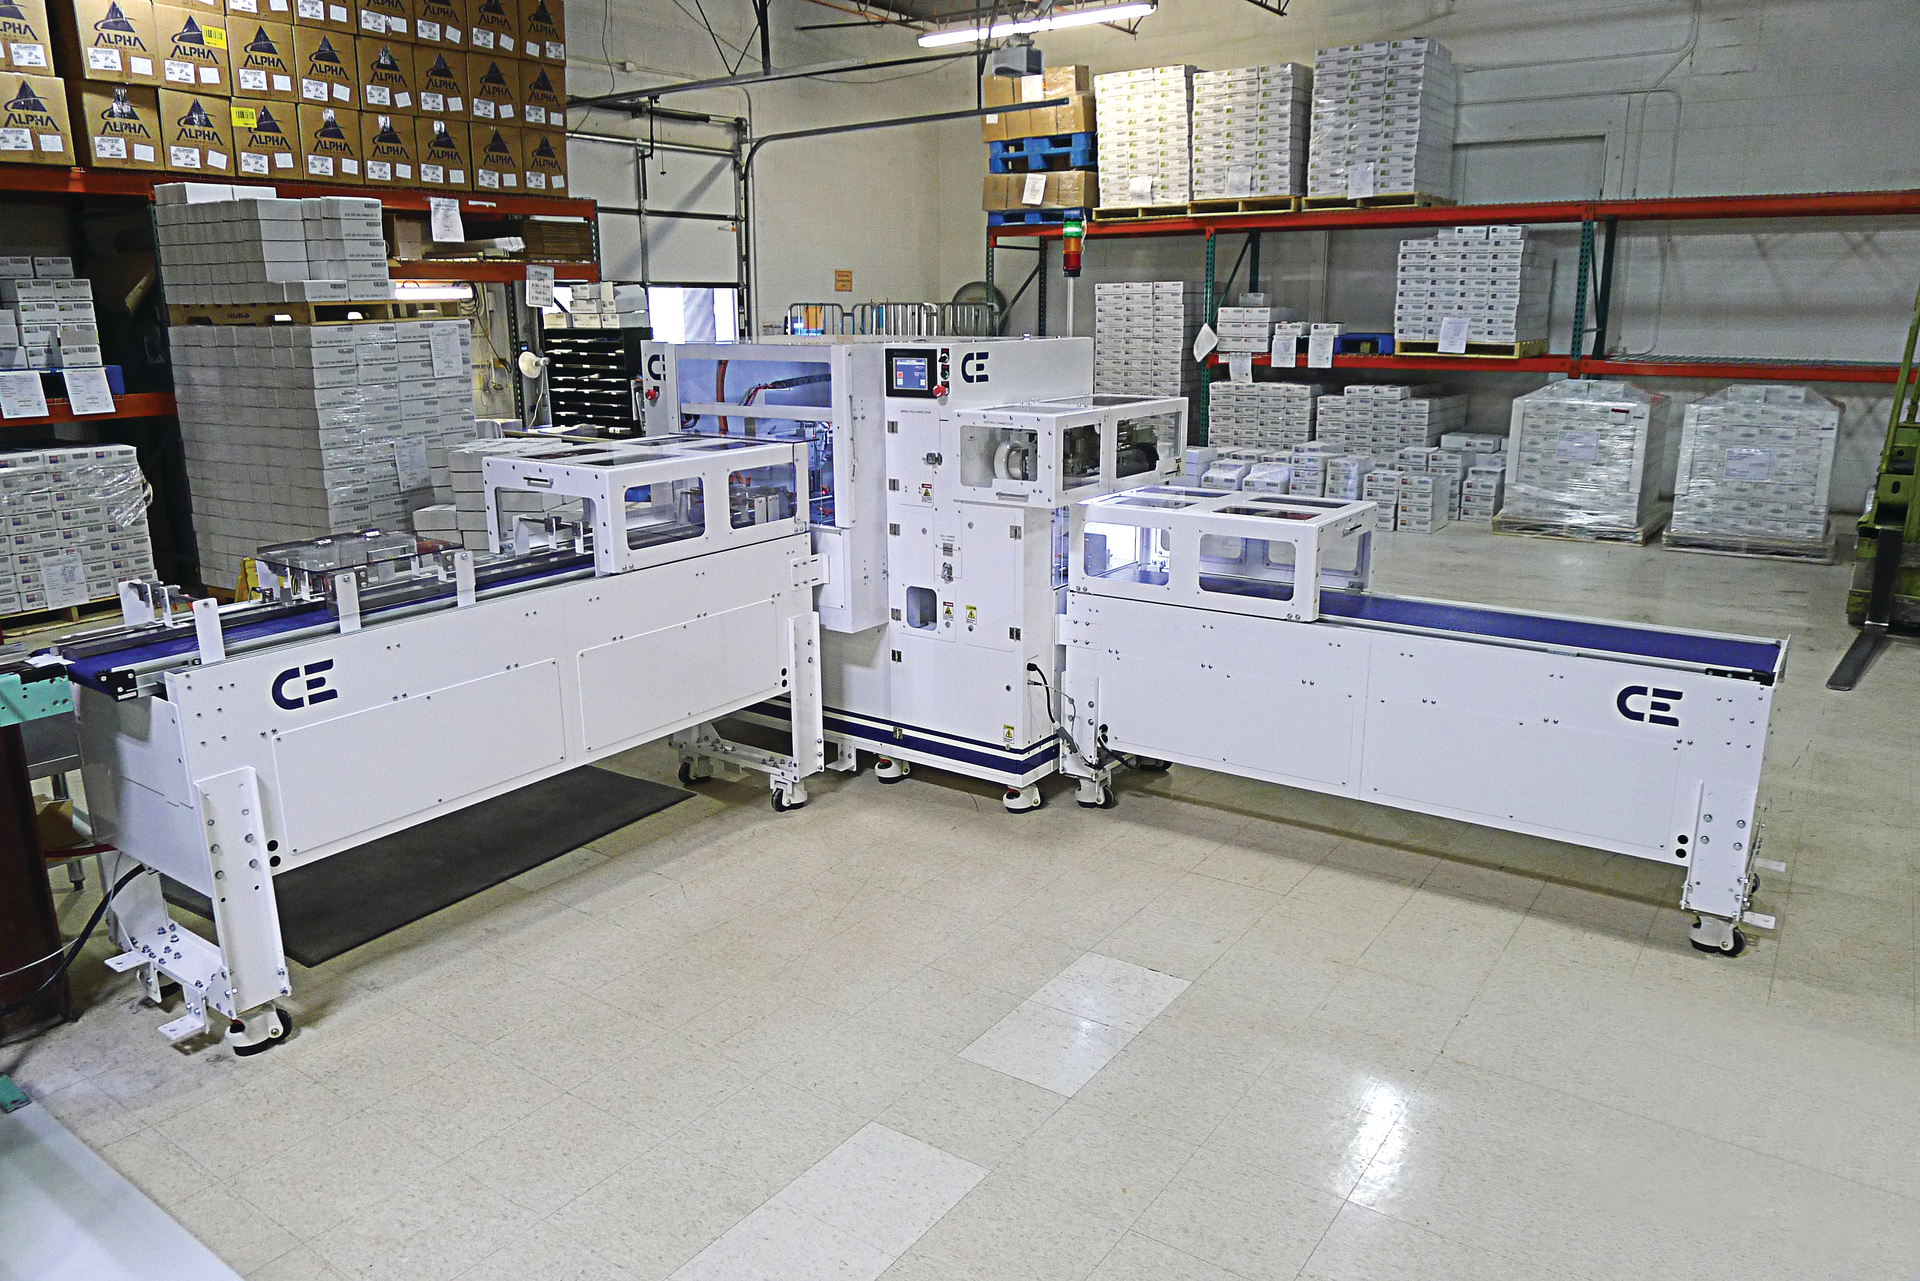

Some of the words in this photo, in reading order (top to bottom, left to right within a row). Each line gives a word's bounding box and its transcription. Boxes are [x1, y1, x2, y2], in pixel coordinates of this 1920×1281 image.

[423, 5, 460, 22] ALPHA
[0, 21, 38, 41] PHA
[478, 14, 512, 31] ALPHA
[528, 23, 559, 40] ALPHA
[94, 32, 147, 52] ALPHA
[170, 44, 219, 64] ALPHA
[244, 54, 288, 72] ALPHA
[308, 62, 350, 80] ALPHA
[370, 72, 408, 88] ALPHA
[425, 78, 461, 94] ALPHA
[479, 84, 513, 100] ALPHA
[529, 91, 560, 107] ALPHA
[4, 113, 60, 132] ALPHA
[101, 122, 151, 138] ALPHA
[176, 128, 224, 146] ALPHA
[248, 134, 292, 150] ALPHA
[314, 140, 354, 156] ALPHA
[372, 144, 410, 160] ALPHA
[427, 150, 463, 164] ALPHA
[483, 154, 516, 168] ALPHA
[530, 158, 562, 172] ALPHA
[961, 352, 989, 383] CE
[272, 658, 338, 710] CE
[1617, 685, 1683, 727] CE
